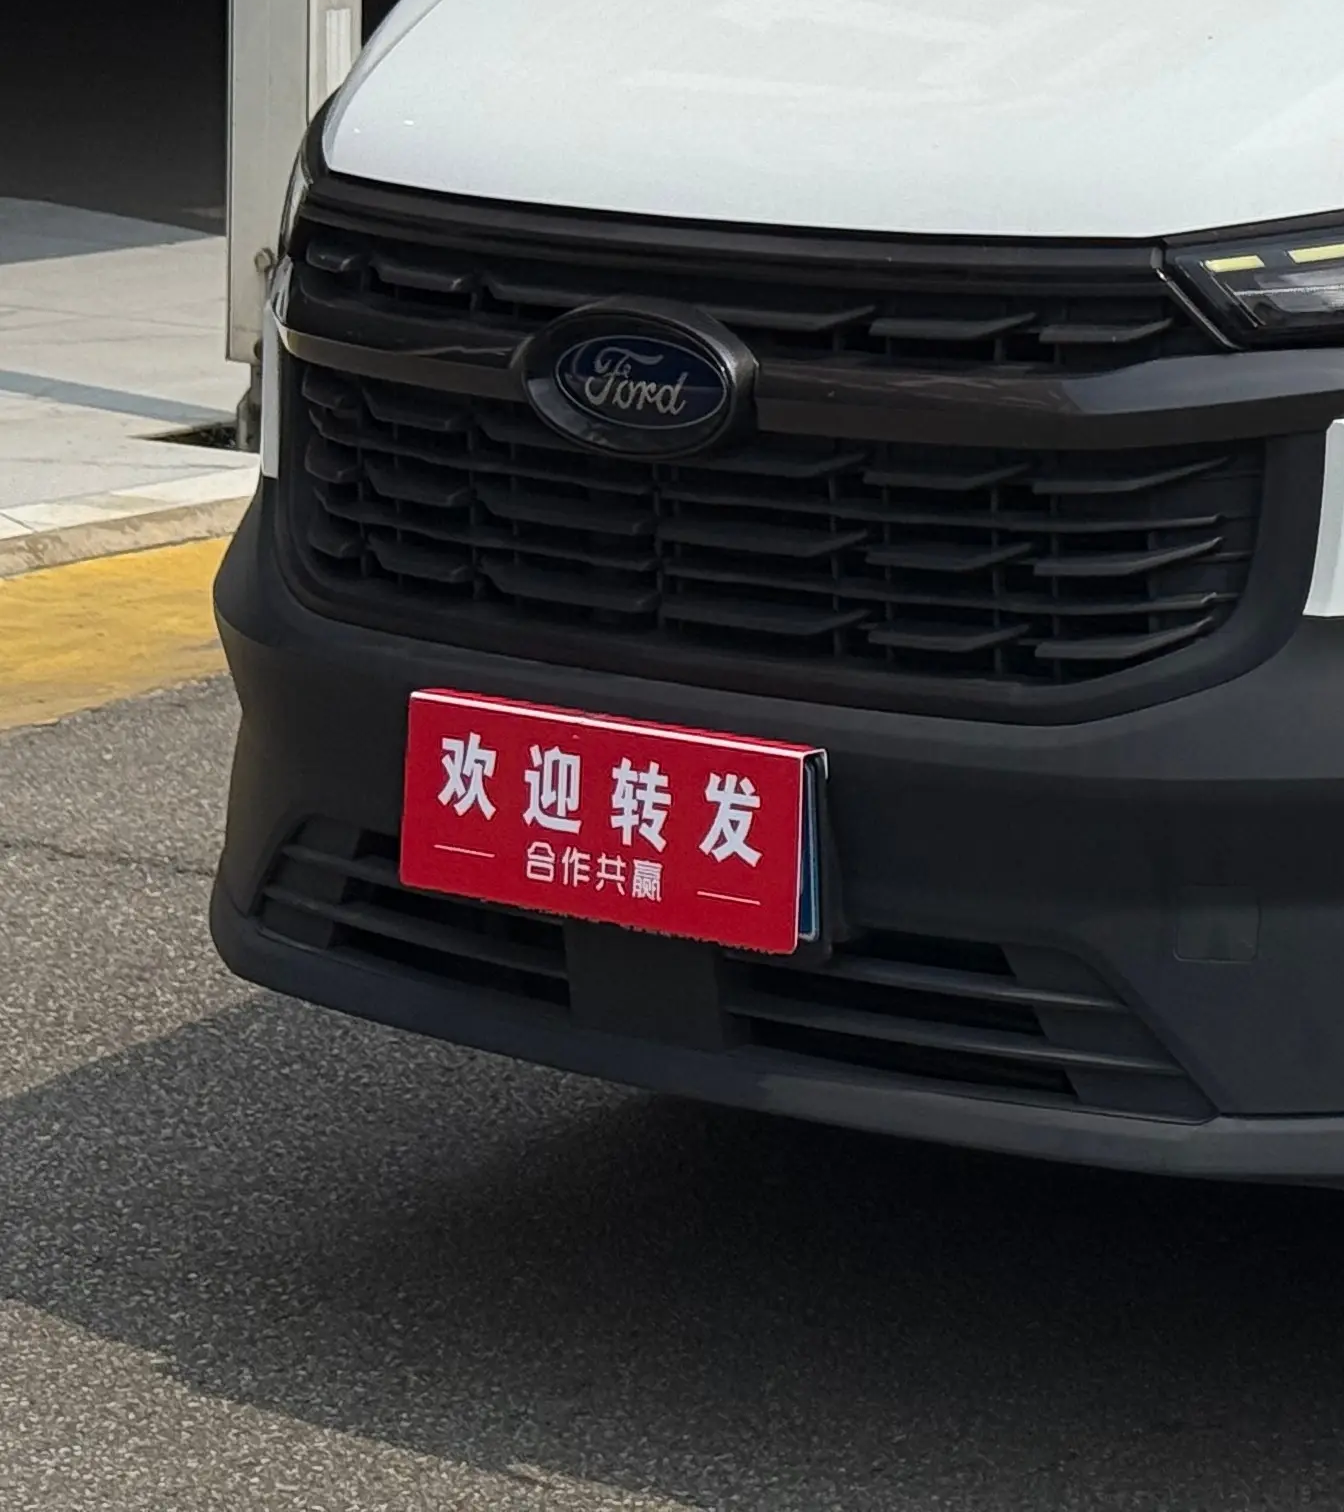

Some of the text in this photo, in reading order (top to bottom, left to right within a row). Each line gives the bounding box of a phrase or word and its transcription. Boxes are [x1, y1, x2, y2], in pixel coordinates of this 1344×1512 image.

[584, 345, 689, 416] Ford
[436, 731, 764, 868] 欢迎转发
[526, 840, 663, 903] 合作共赢
